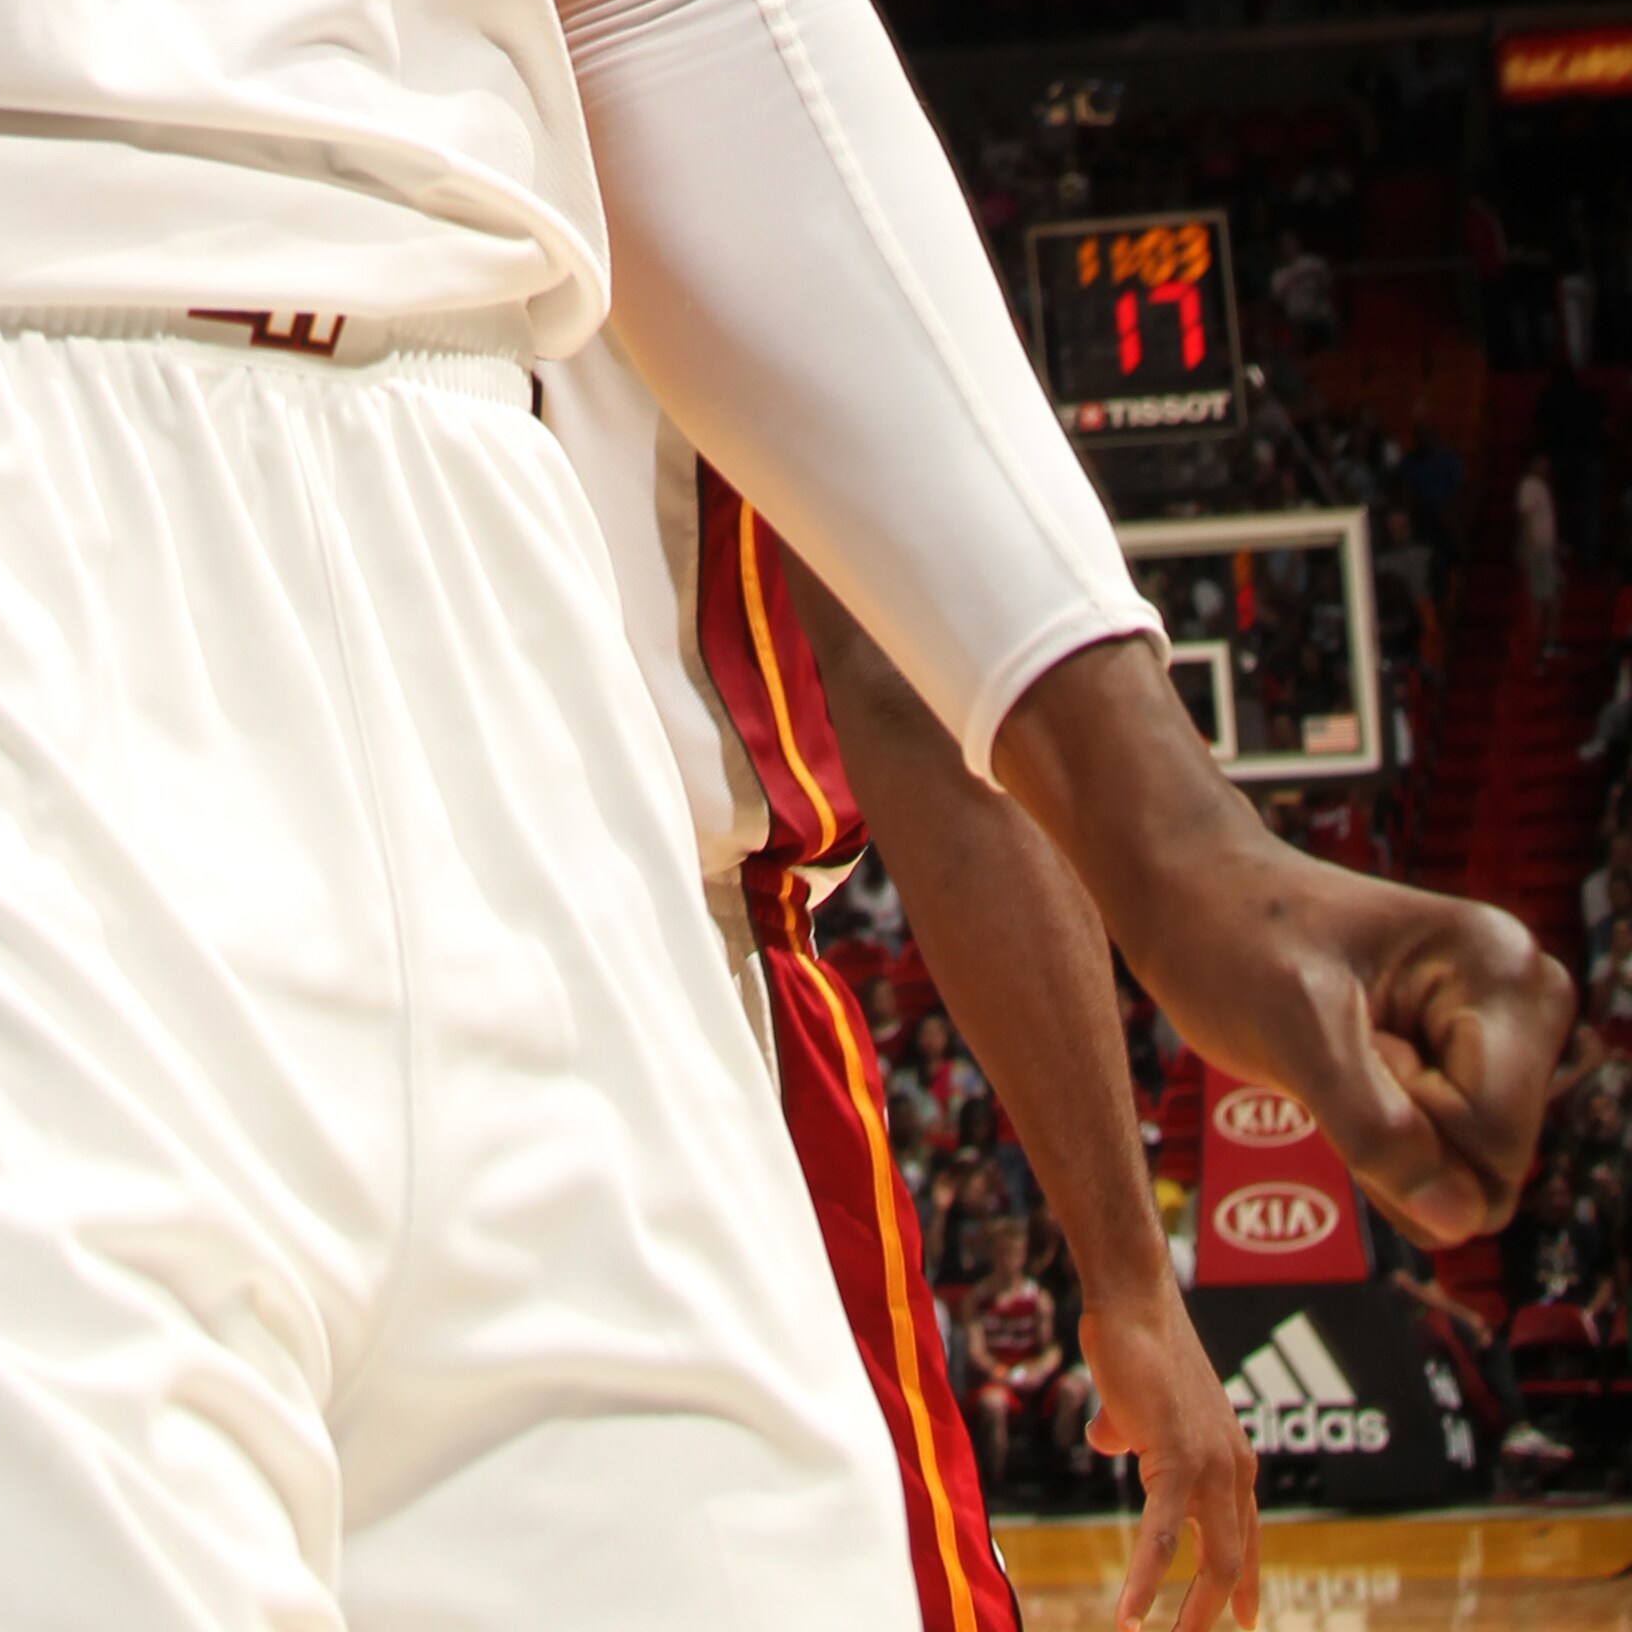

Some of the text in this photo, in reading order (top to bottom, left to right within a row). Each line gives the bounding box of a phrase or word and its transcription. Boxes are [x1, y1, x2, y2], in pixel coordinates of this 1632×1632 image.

[1115, 279, 1206, 376] 17
[1108, 391, 1231, 429] TISSOT
[1231, 1097, 1305, 1135] KIA
[1235, 1195, 1319, 1238] KIA
[1237, 1398, 1390, 1454] didas
